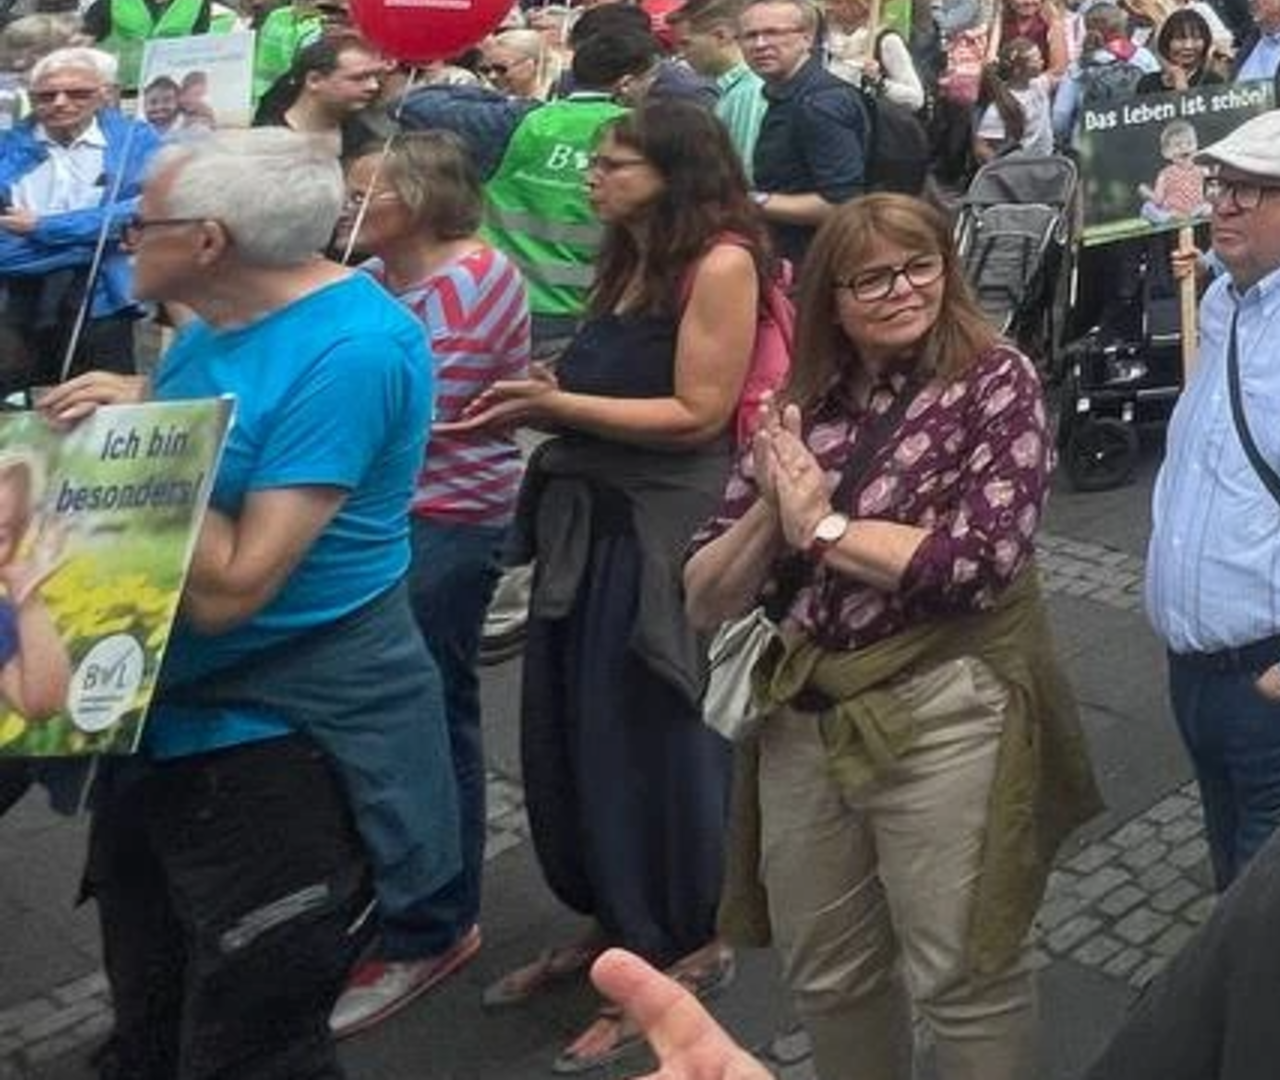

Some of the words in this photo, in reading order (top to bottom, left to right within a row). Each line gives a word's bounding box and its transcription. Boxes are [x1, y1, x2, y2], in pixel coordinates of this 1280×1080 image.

[1084, 110, 1117, 131] Das
[1123, 101, 1175, 124] Leben
[1180, 94, 1206, 115] ist
[1211, 84, 1267, 111] schön!
[101, 428, 140, 461] Ich
[147, 425, 190, 458] bin
[56, 472, 204, 513] besonders!
